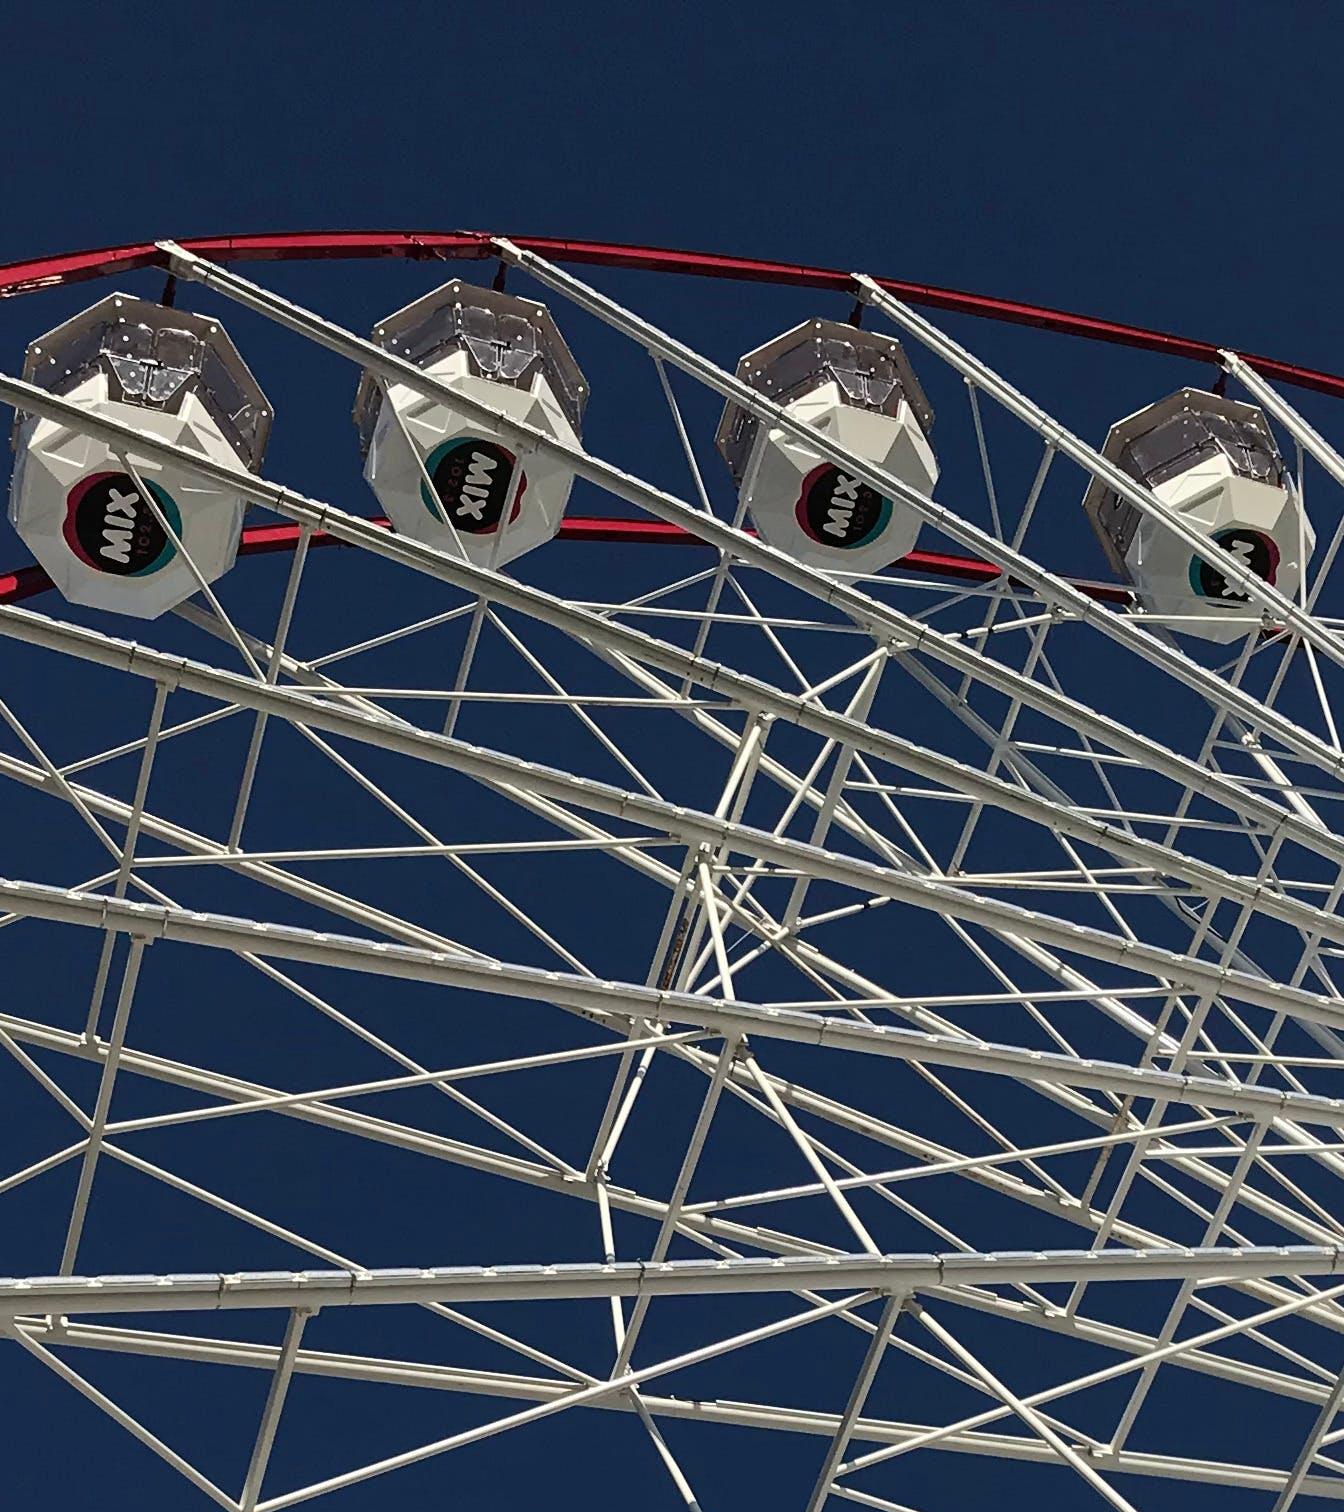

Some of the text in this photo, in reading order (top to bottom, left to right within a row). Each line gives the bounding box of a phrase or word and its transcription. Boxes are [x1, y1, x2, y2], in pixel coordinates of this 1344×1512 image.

[456, 452, 498, 521] MIX
[822, 475, 863, 538] MIX
[99, 488, 140, 564] MIX
